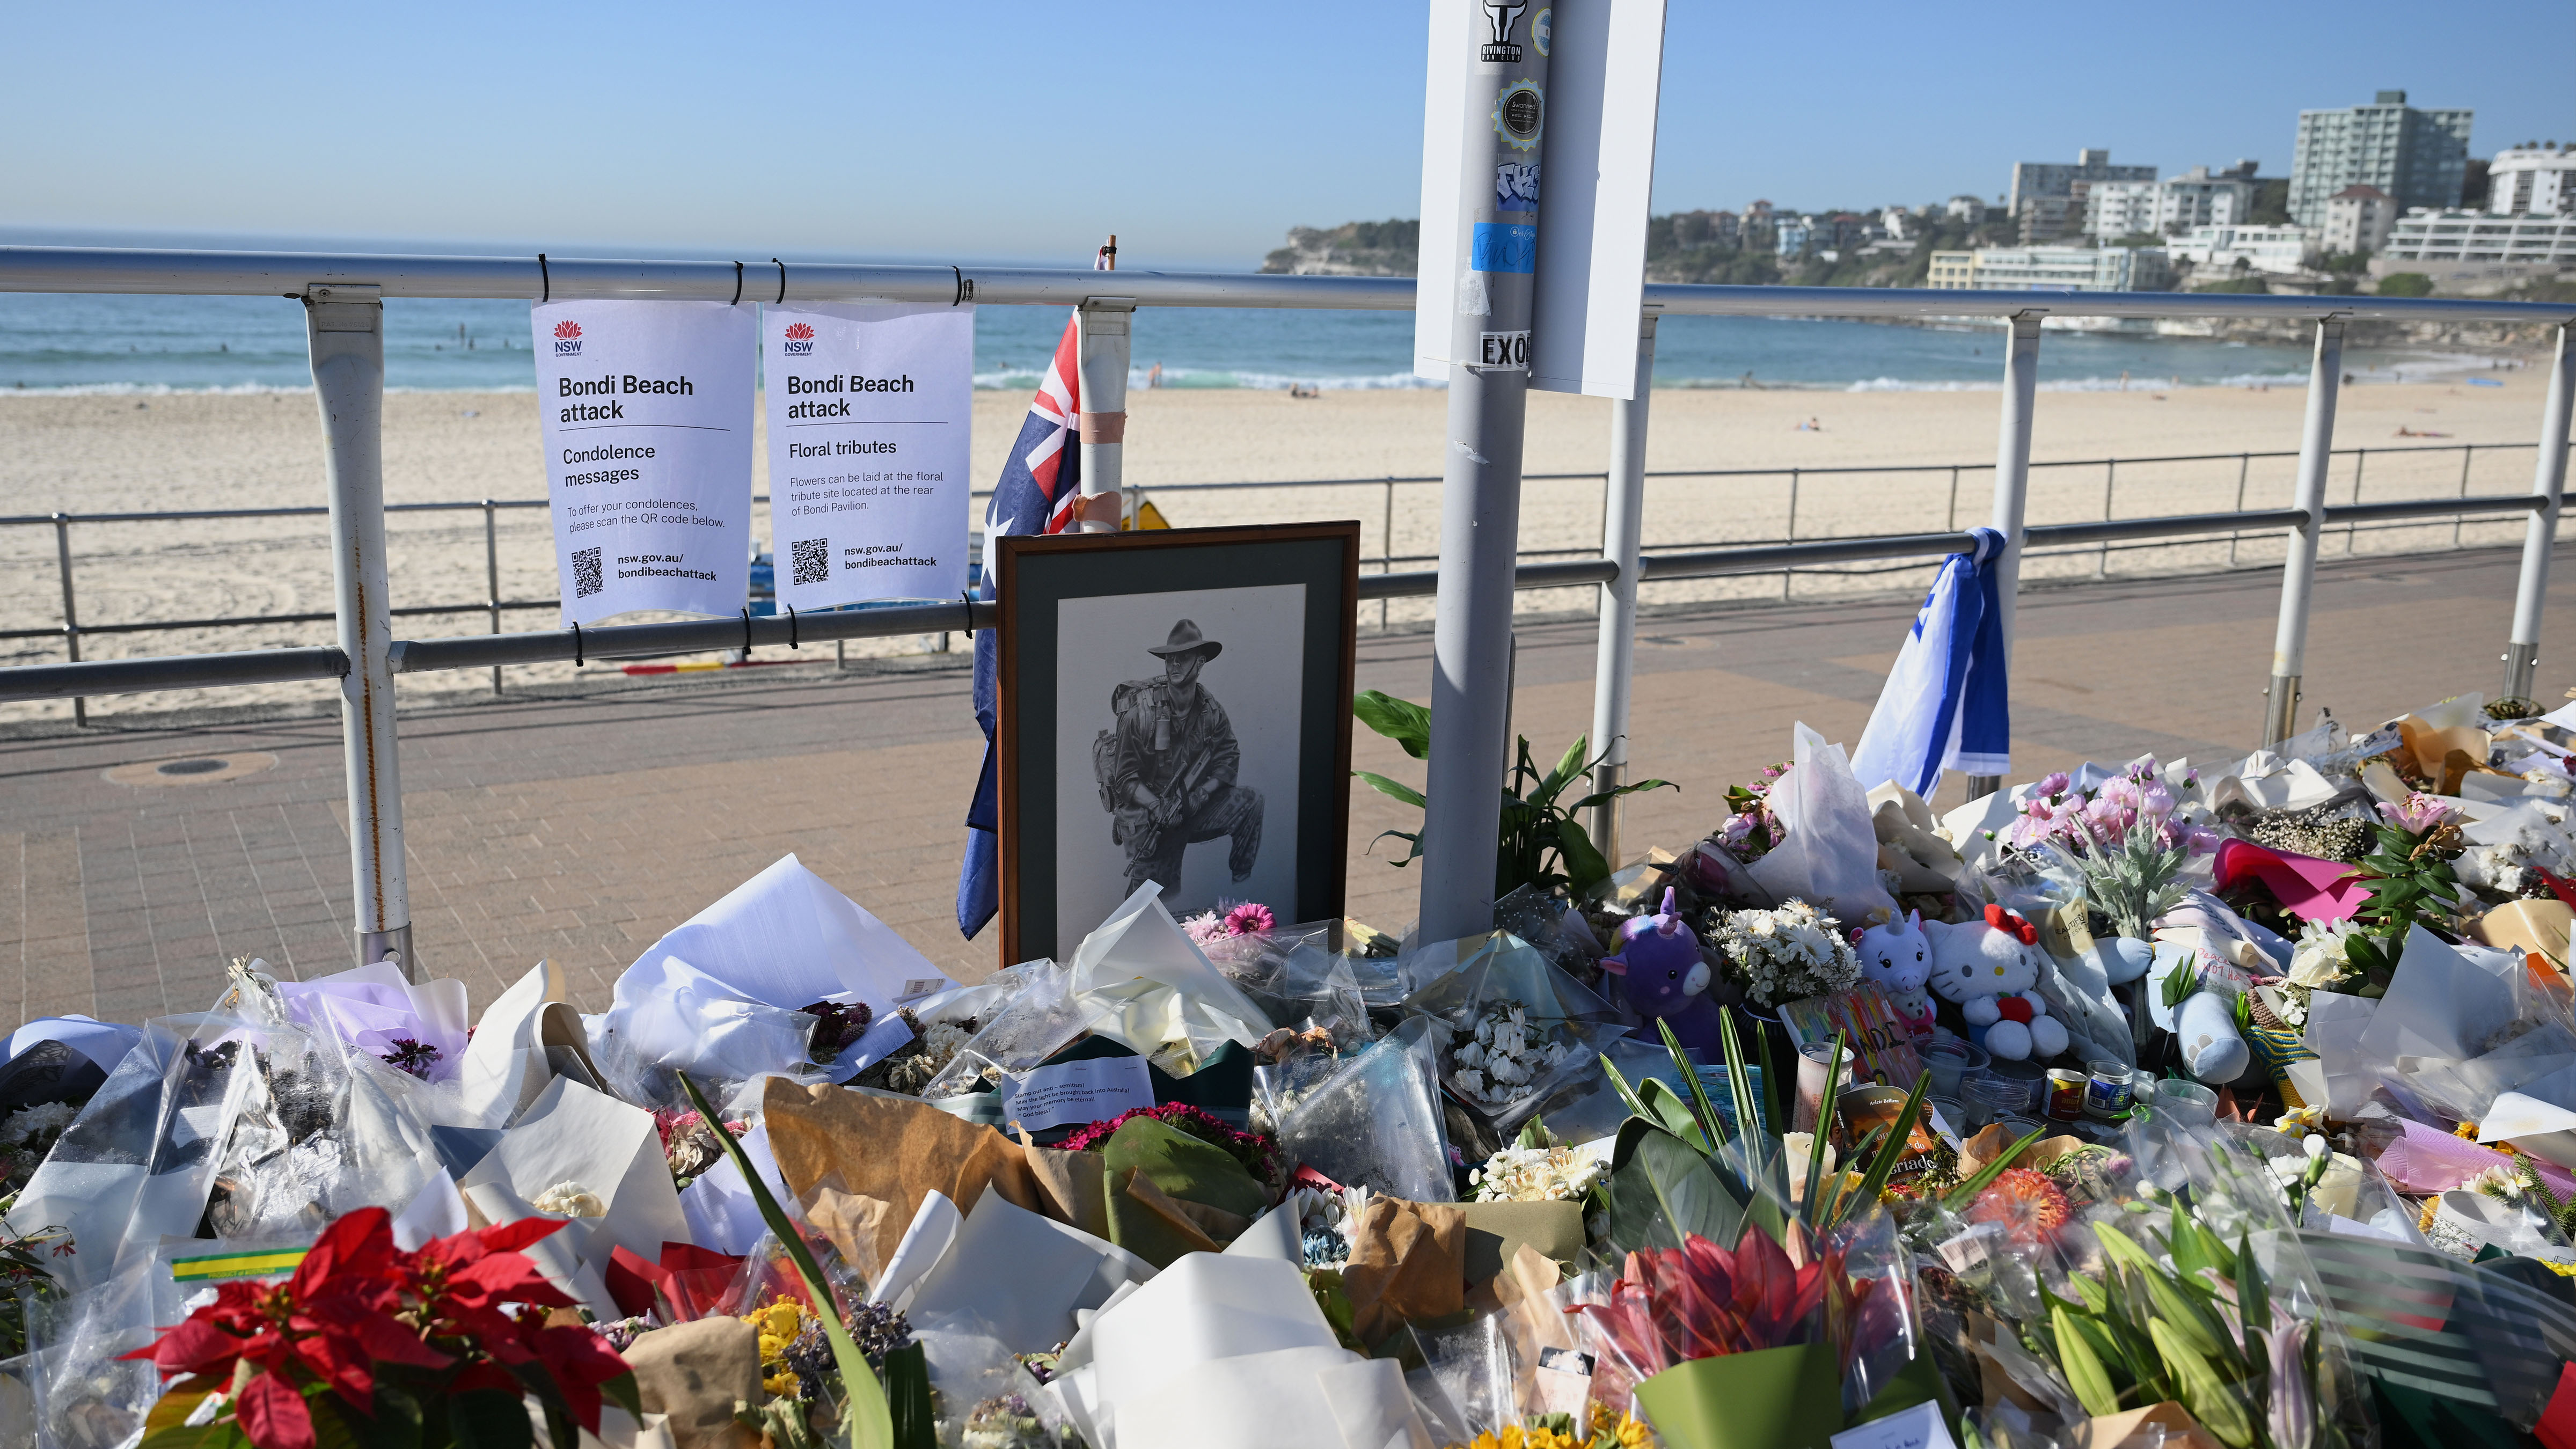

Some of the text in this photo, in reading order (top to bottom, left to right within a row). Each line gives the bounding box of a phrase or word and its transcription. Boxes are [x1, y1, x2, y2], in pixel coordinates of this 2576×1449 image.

[1482, 46, 1521, 55] RIVINGTON
[1512, 101, 1535, 109] Swanned
[555, 341, 582, 353] NSW
[785, 342, 813, 353] NSW
[559, 375, 693, 397] Bondi Beach
[788, 375, 914, 394] Bondi Beach
[561, 400, 624, 423] attack
[788, 398, 851, 419] attack
[564, 444, 655, 464] Condolence
[789, 440, 897, 458] Floral tributes
[565, 469, 639, 487] messages
[791, 471, 943, 487] Flowers can be laid at the floral
[791, 485, 934, 502] tribute site located at the rear
[568, 499, 698, 517] To offer your condolences,
[792, 501, 869, 516] of Bondi Pavilion.
[569, 513, 725, 535] please scan the QR code below.
[845, 543, 903, 556] nsw.gov.au/
[618, 553, 684, 564] nsw.gov.au/
[845, 557, 937, 569] bondibeachattack
[618, 567, 716, 581] bondibeachattack
[2198, 948, 2230, 966] Peace
[2203, 963, 2224, 977] NOT
[1043, 1098, 1066, 1107] memory
[1914, 1140, 1926, 1150] do
